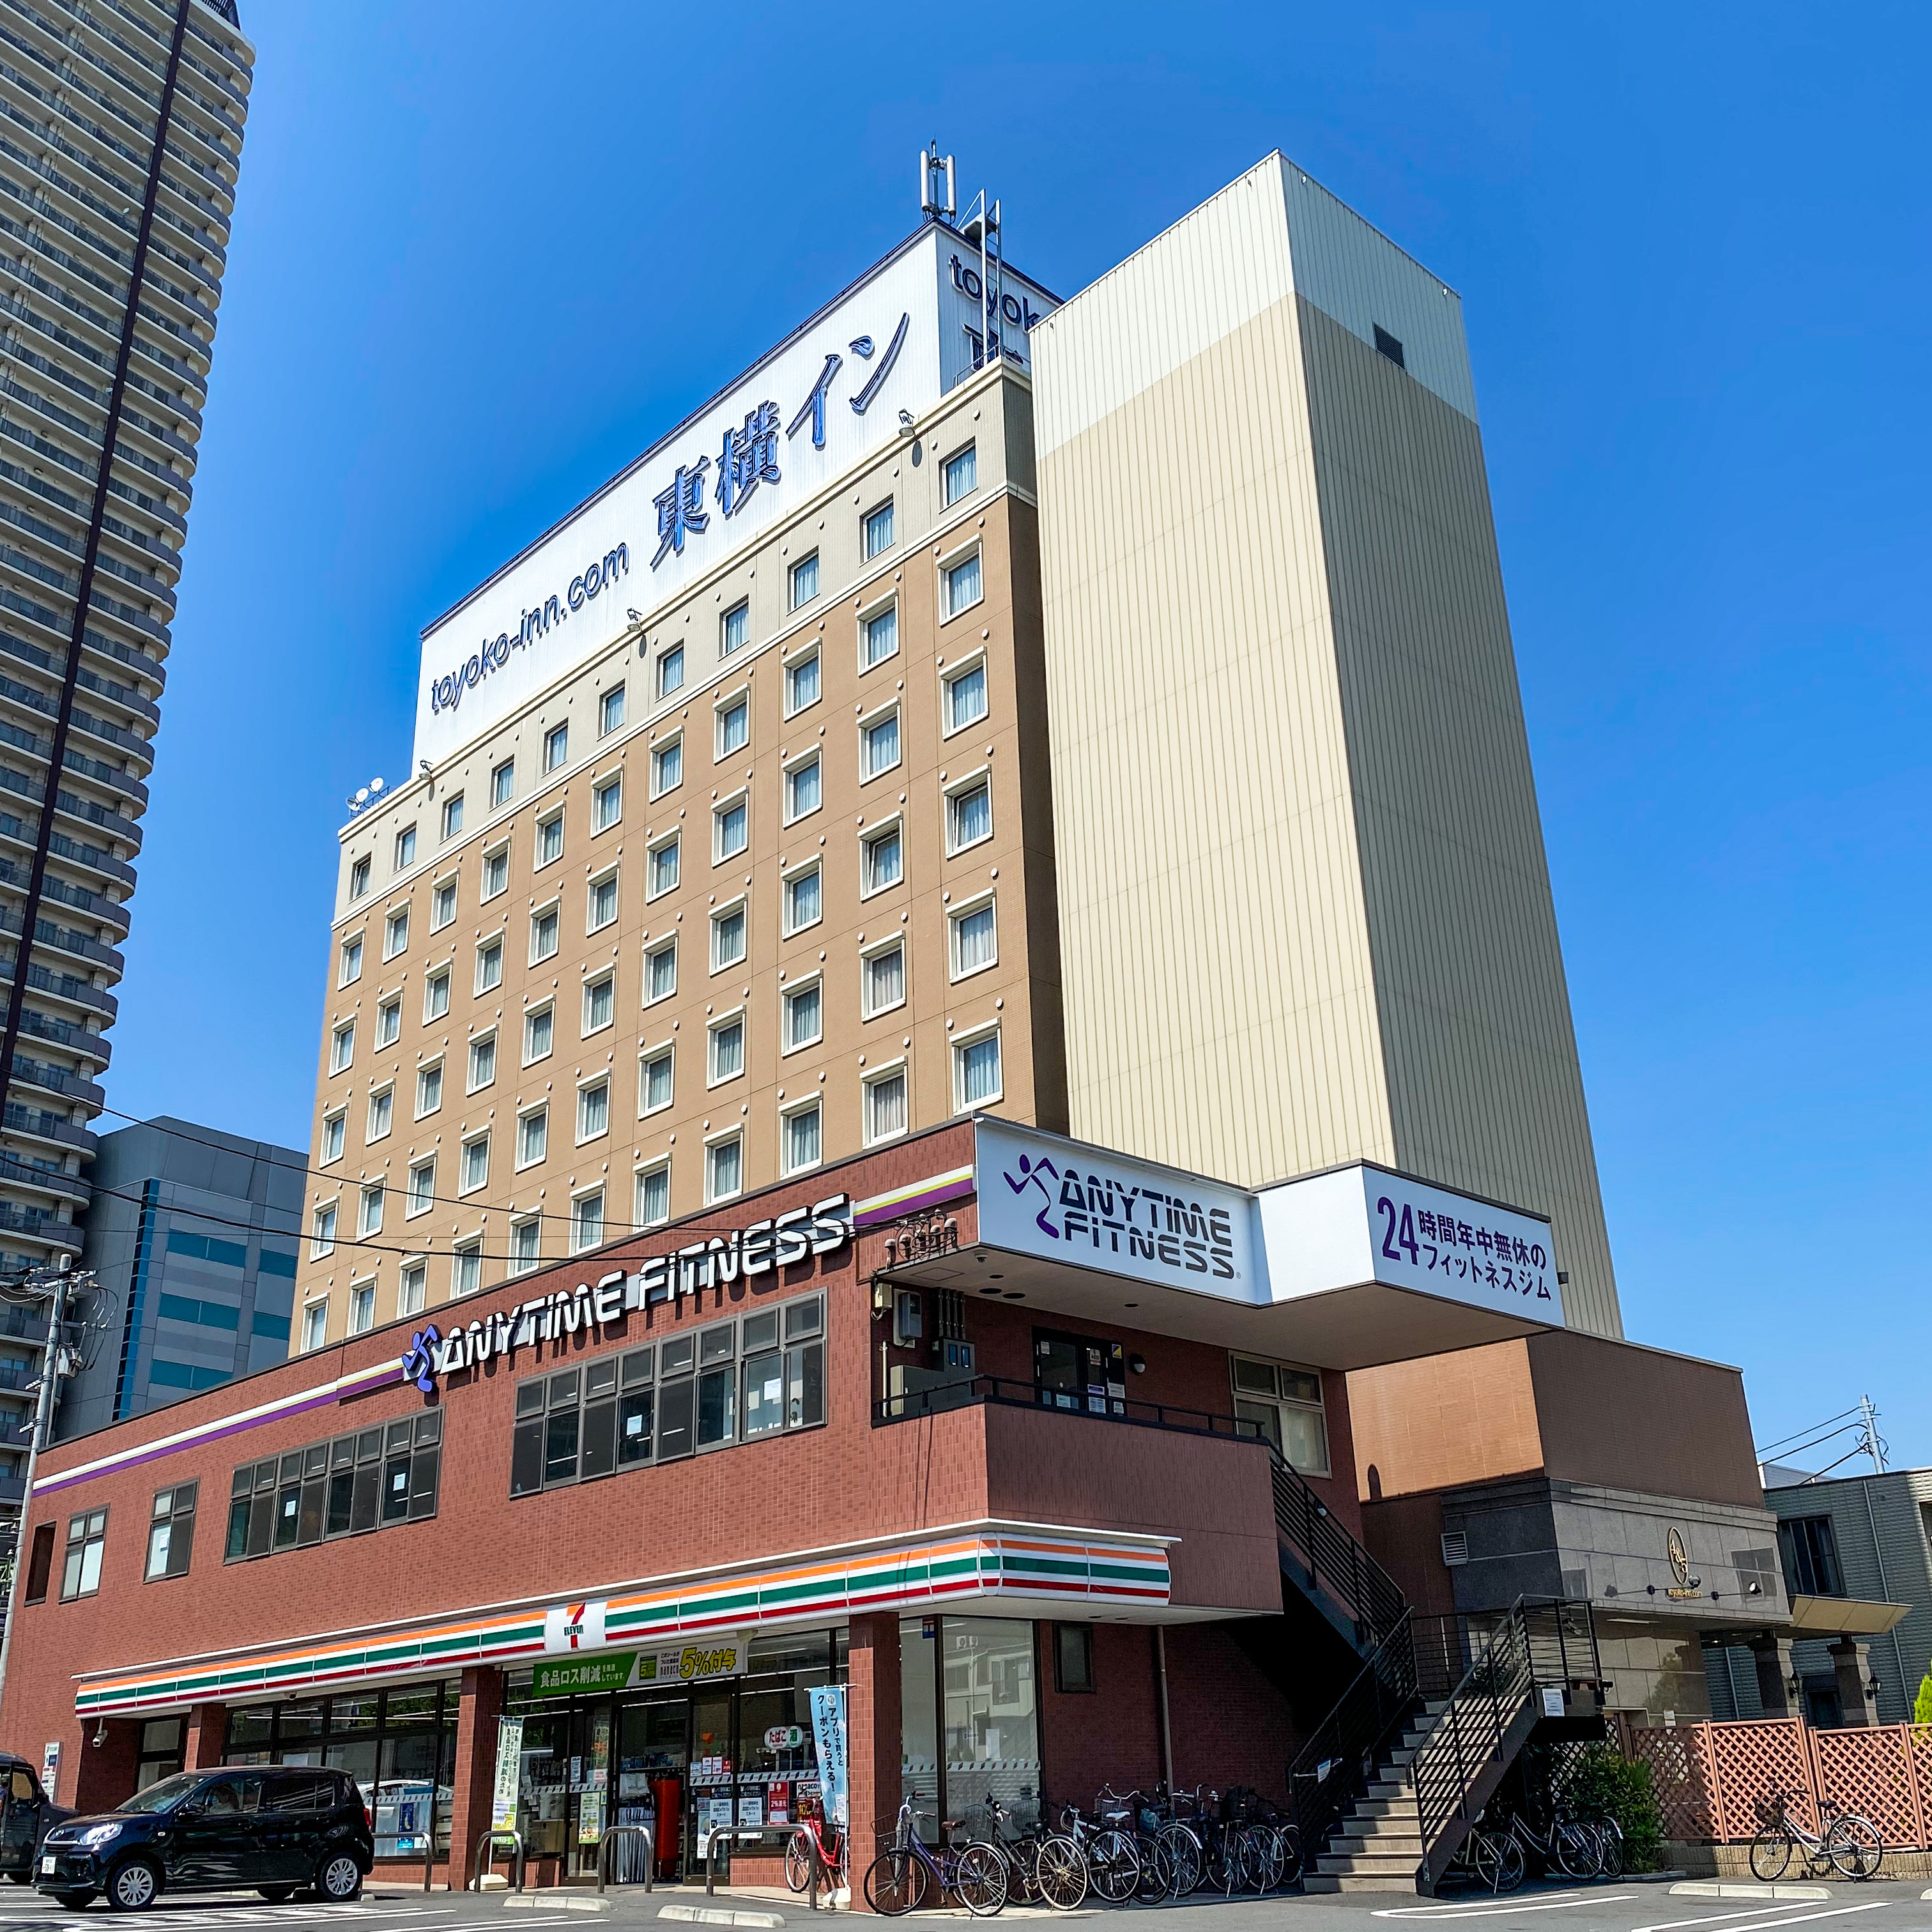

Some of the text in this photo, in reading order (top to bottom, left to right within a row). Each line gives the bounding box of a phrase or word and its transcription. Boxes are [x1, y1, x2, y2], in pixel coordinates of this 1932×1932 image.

[949, 254, 1040, 333] toyok
[650, 312, 909, 570] 東横イン
[432, 542, 629, 714] toyoko-inn.com
[1059, 1169, 1232, 1247] ANYTIME
[1422, 1243, 1551, 1301] フィットネスジム
[440, 1269, 625, 1374] ANYTIME
[540, 1664, 601, 1688] 食品ロス削減
[679, 1647, 737, 1679] 5%付与
[769, 1729, 798, 1743] たばこ 酒
[829, 1707, 843, 1767] アプリで買うと
